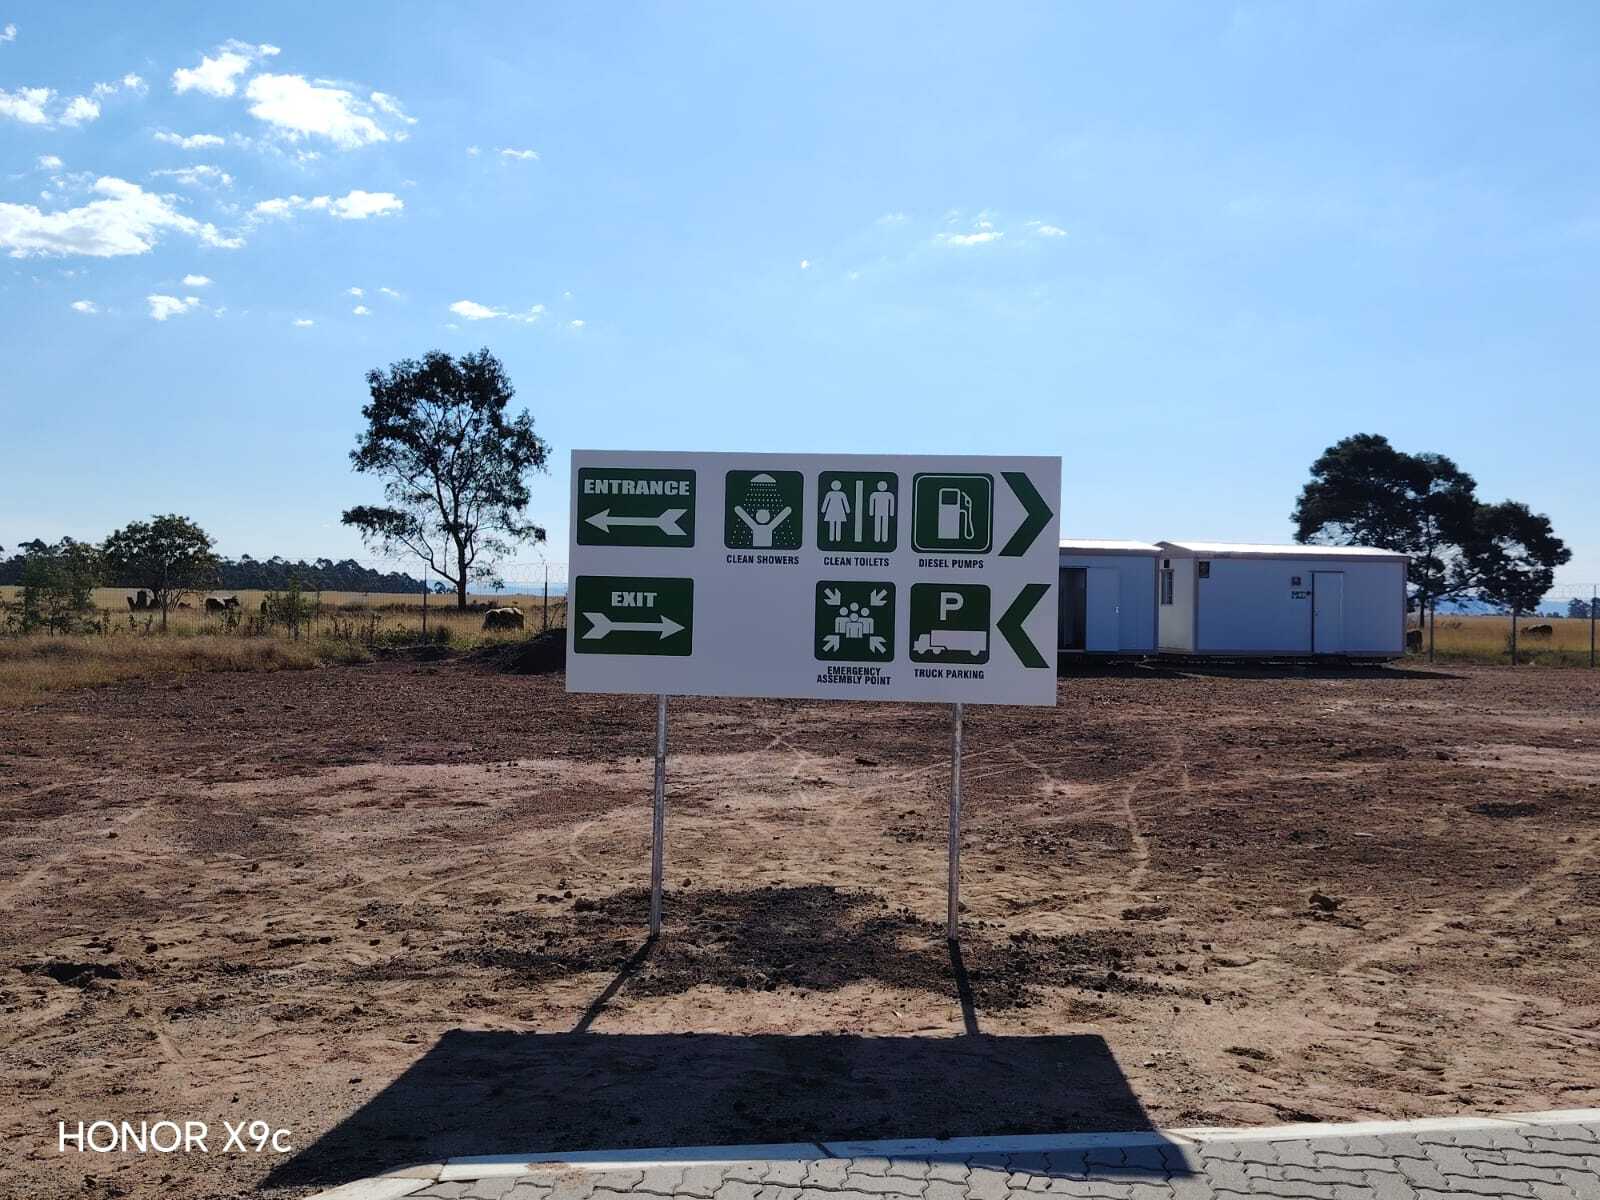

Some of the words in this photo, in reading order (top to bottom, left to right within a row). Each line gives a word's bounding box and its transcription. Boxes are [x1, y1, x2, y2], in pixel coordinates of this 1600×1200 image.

[583, 479, 690, 496] ENTRANCE
[726, 555, 754, 564] CLEAN
[756, 555, 799, 565] SHOWERS
[823, 557, 851, 567] CLEAN
[854, 557, 889, 567] TOILETS
[919, 559, 949, 568] DIESEL
[951, 559, 984, 569] PUMPS
[611, 591, 657, 608] EXIT
[940, 592, 964, 620] P
[827, 666, 881, 676] EMERGENCY
[914, 669, 943, 678] TRUCK
[946, 670, 985, 679] PARKING
[817, 675, 862, 684] ASSEMBLY
[864, 676, 891, 685] POINT
